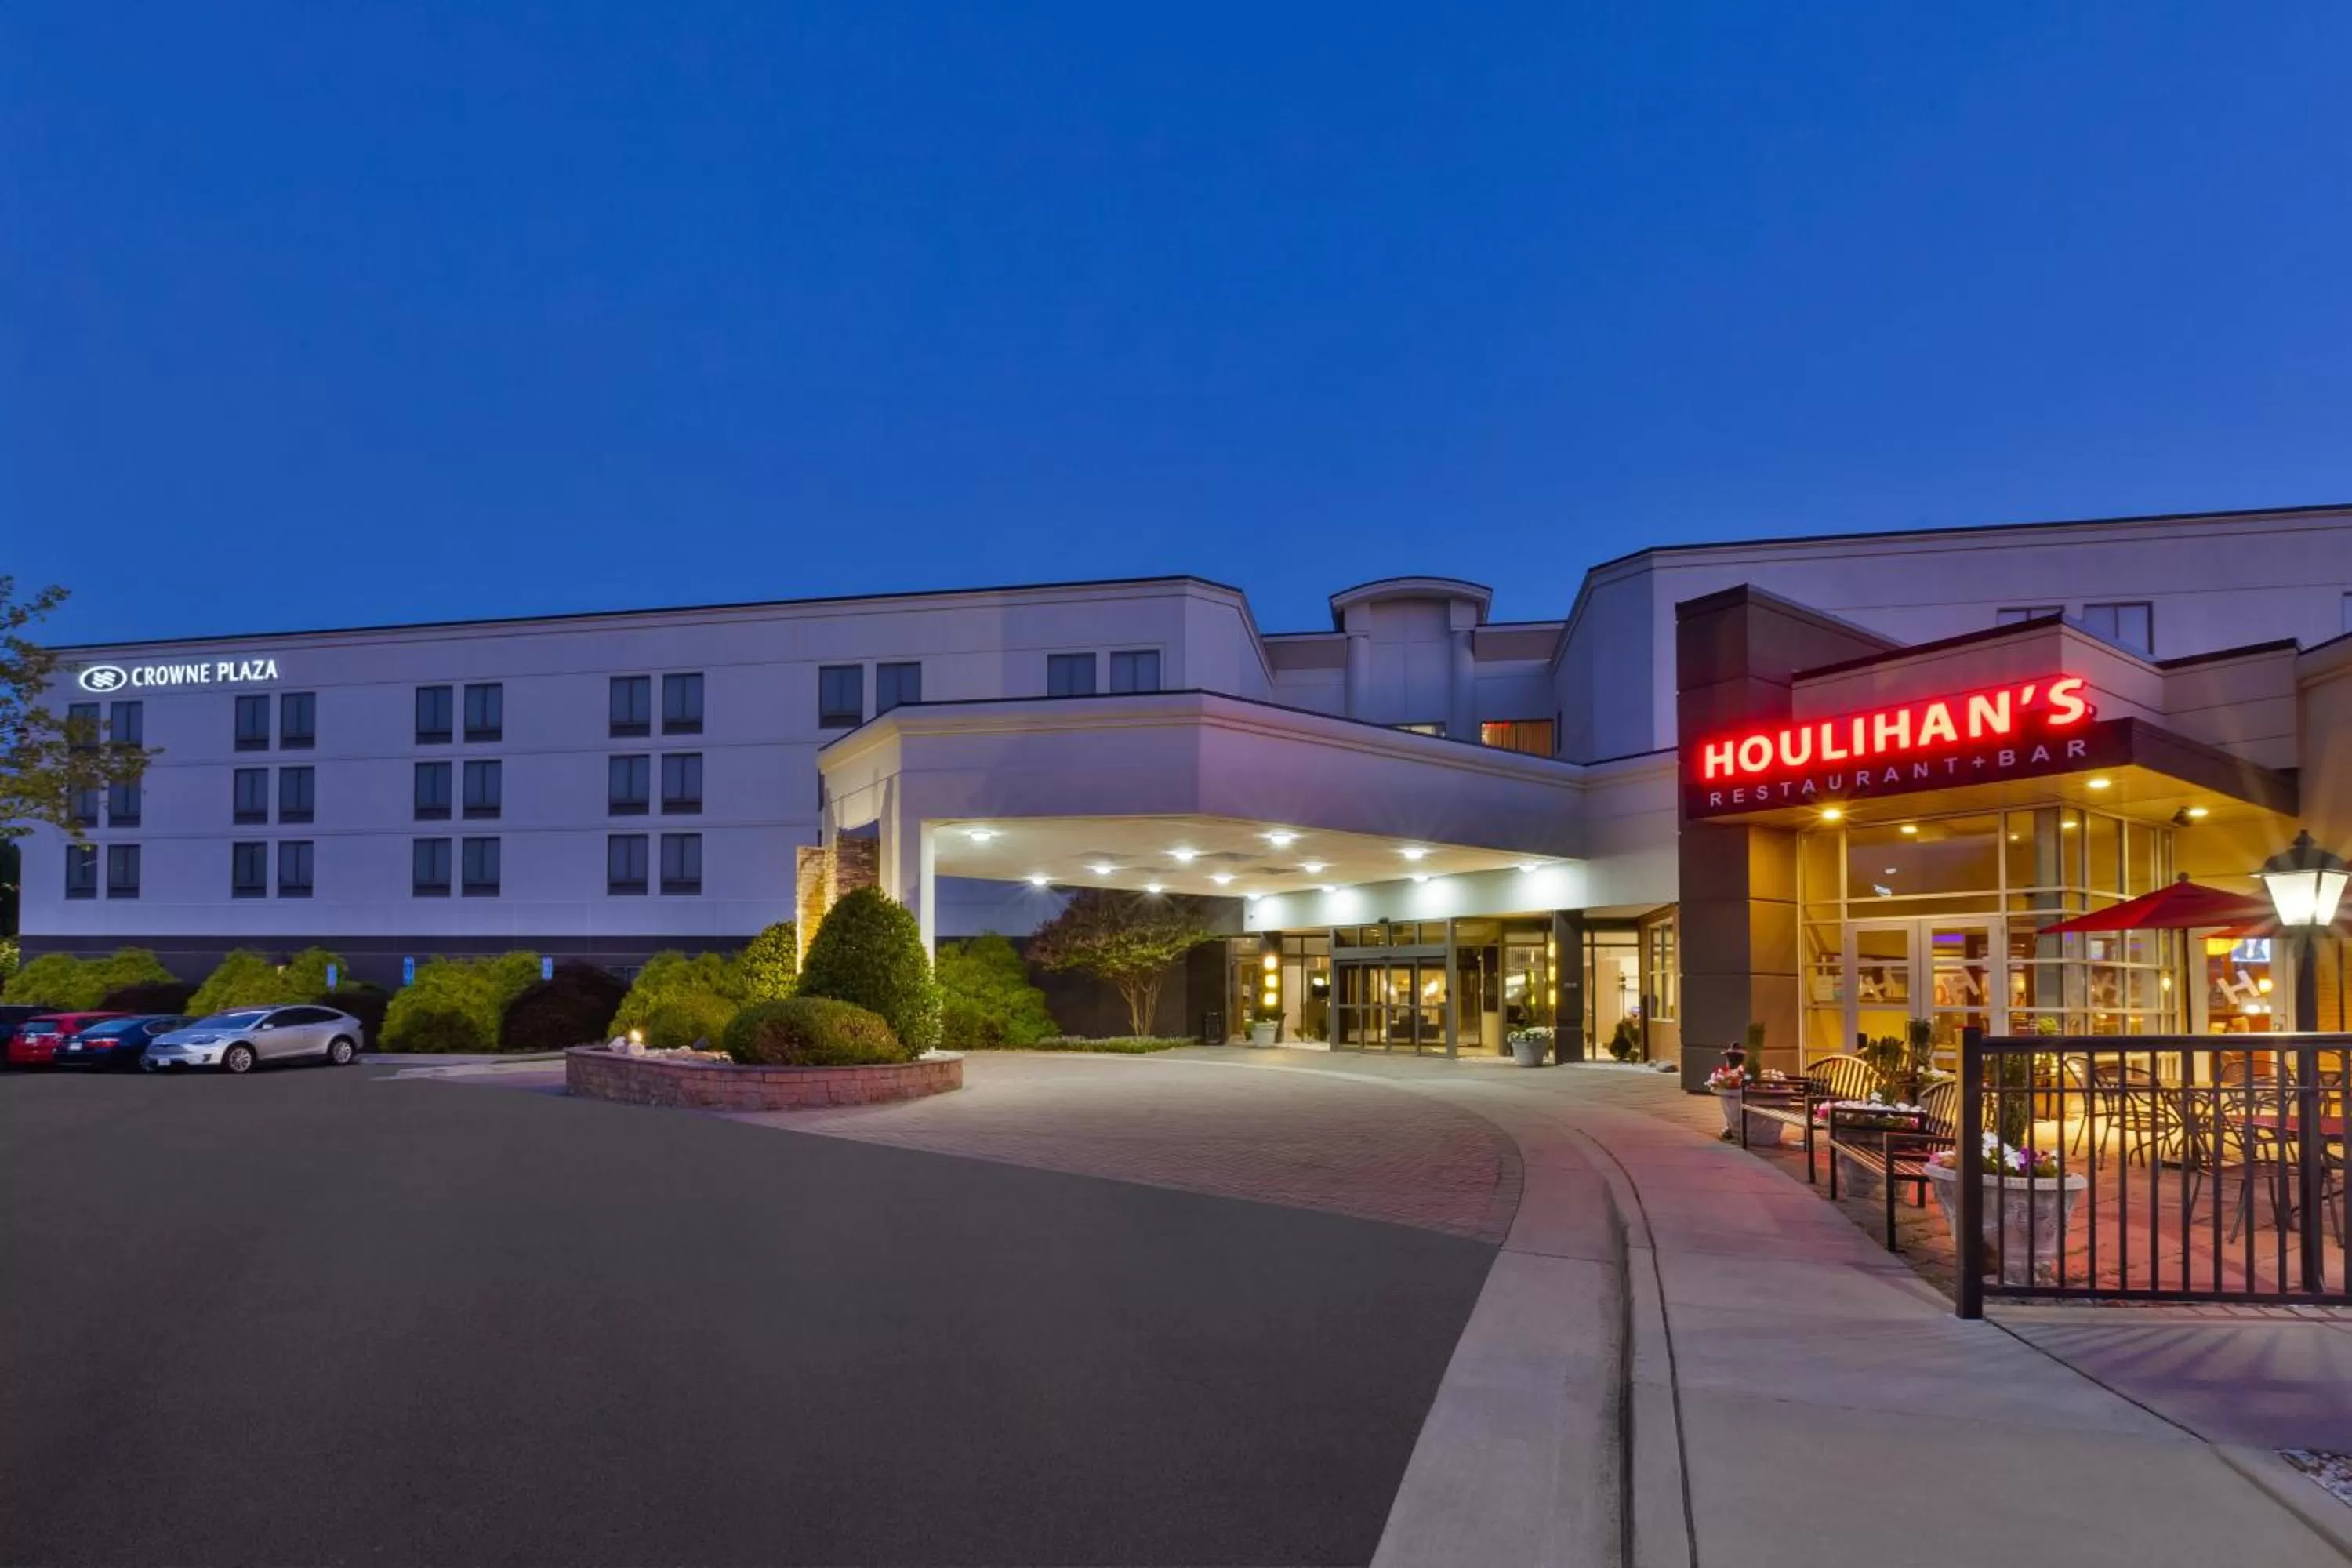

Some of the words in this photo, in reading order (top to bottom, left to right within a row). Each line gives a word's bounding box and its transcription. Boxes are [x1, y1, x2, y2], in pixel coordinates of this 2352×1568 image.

[132, 663, 210, 687] CROWNE
[217, 659, 278, 682] PLAZA
[1704, 677, 2086, 779] HOULIHAN'S
